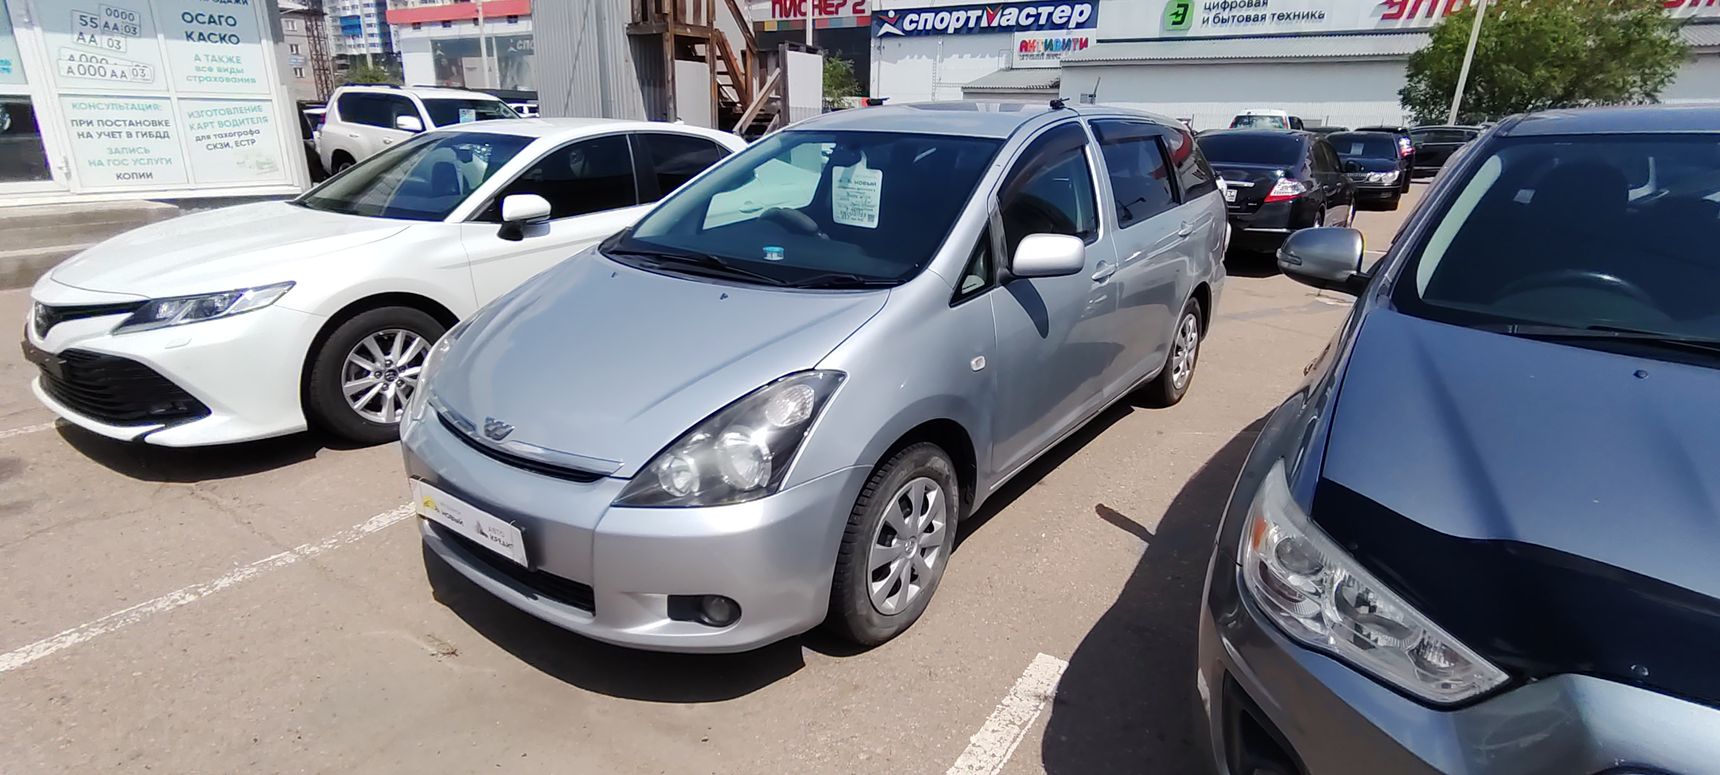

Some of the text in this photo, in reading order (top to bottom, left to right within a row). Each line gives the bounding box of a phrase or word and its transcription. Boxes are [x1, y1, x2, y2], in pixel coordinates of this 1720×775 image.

[852, 0, 866, 15] 2
[1203, 0, 1269, 12] цифровая
[105, 7, 135, 22] 0000
[181, 11, 237, 27] ОСАГО
[1202, 10, 1326, 25] и бытовая техника
[79, 14, 99, 29] 55
[124, 25, 138, 35] 03
[184, 30, 241, 45] КАСКО
[106, 38, 122, 50] 03
[194, 54, 242, 64] А ТАКЖЕ
[216, 66, 244, 75] виды
[186, 75, 257, 84] страхования
[186, 104, 264, 119] ИЗГОТОВЛЕНИЕ
[70, 119, 171, 127] ПРИ ПОСТАНОВКЕ
[188, 116, 269, 131] КАРТ ВОДИТЕЛЯ
[76, 131, 171, 139] НА УЧЕТ В ГИБДД
[194, 128, 261, 142] для тахографа
[234, 138, 257, 148] ЕСТР
[106, 146, 151, 155] ЗАПИСЬ
[87, 157, 173, 167] НА ГОС УСЛУГИ
[115, 172, 154, 181] КОПИИ
